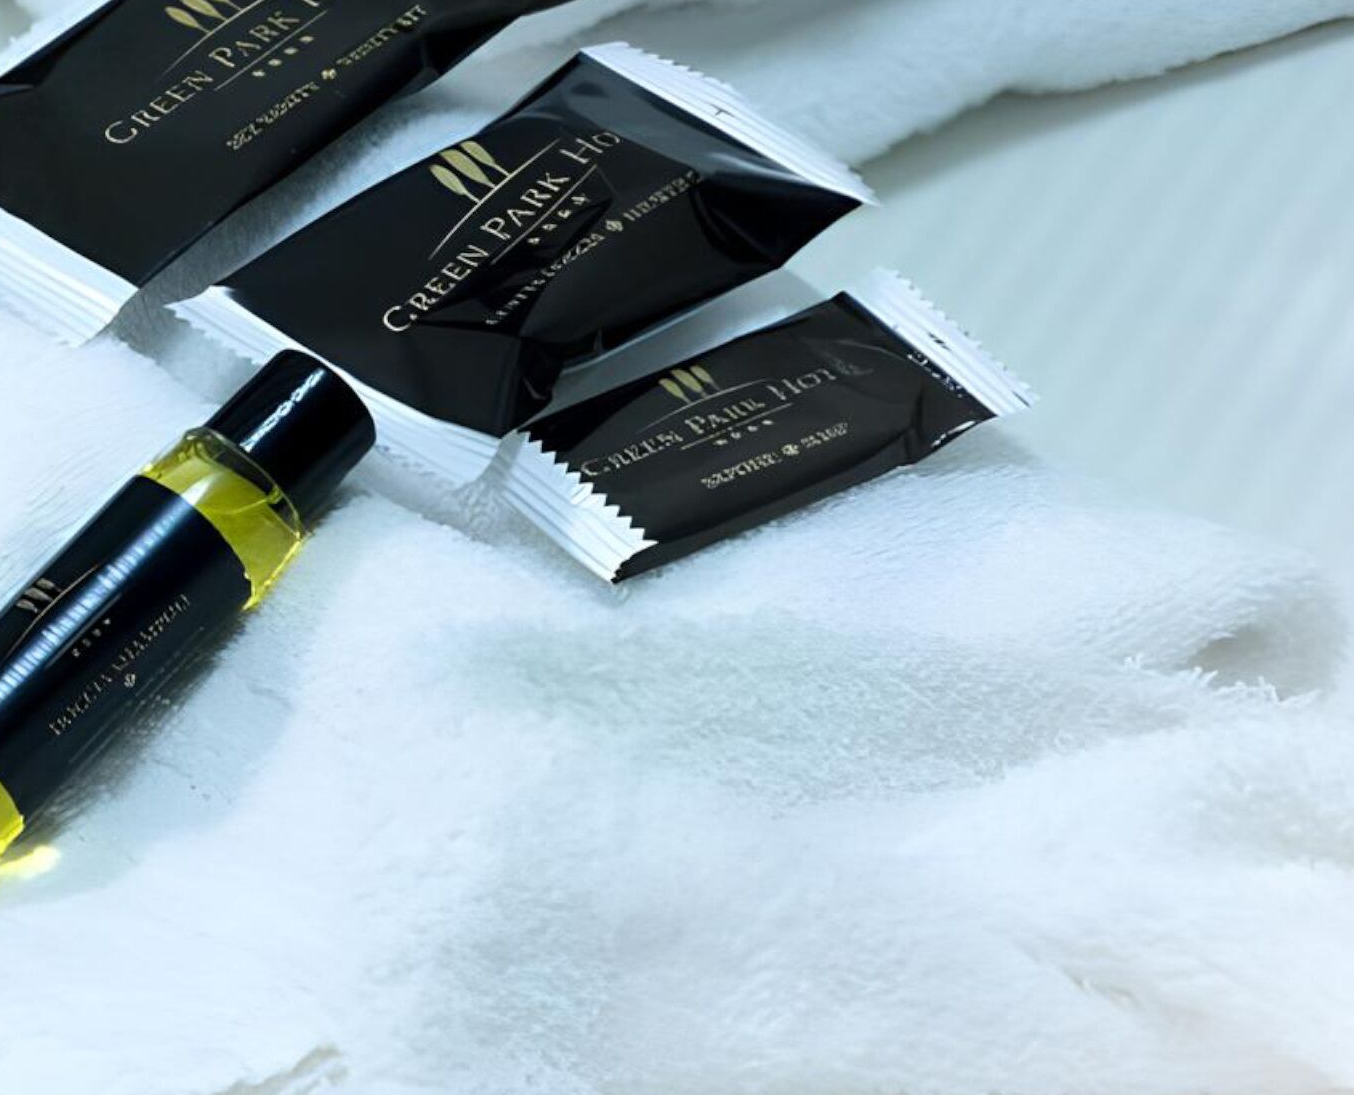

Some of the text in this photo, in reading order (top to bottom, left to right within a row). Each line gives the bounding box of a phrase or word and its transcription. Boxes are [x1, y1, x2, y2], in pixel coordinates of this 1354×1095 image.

[104, 69, 214, 144] GREEN
[209, 10, 300, 68] PARK
[382, 244, 490, 332] GREEN
[481, 172, 570, 240] PARK
